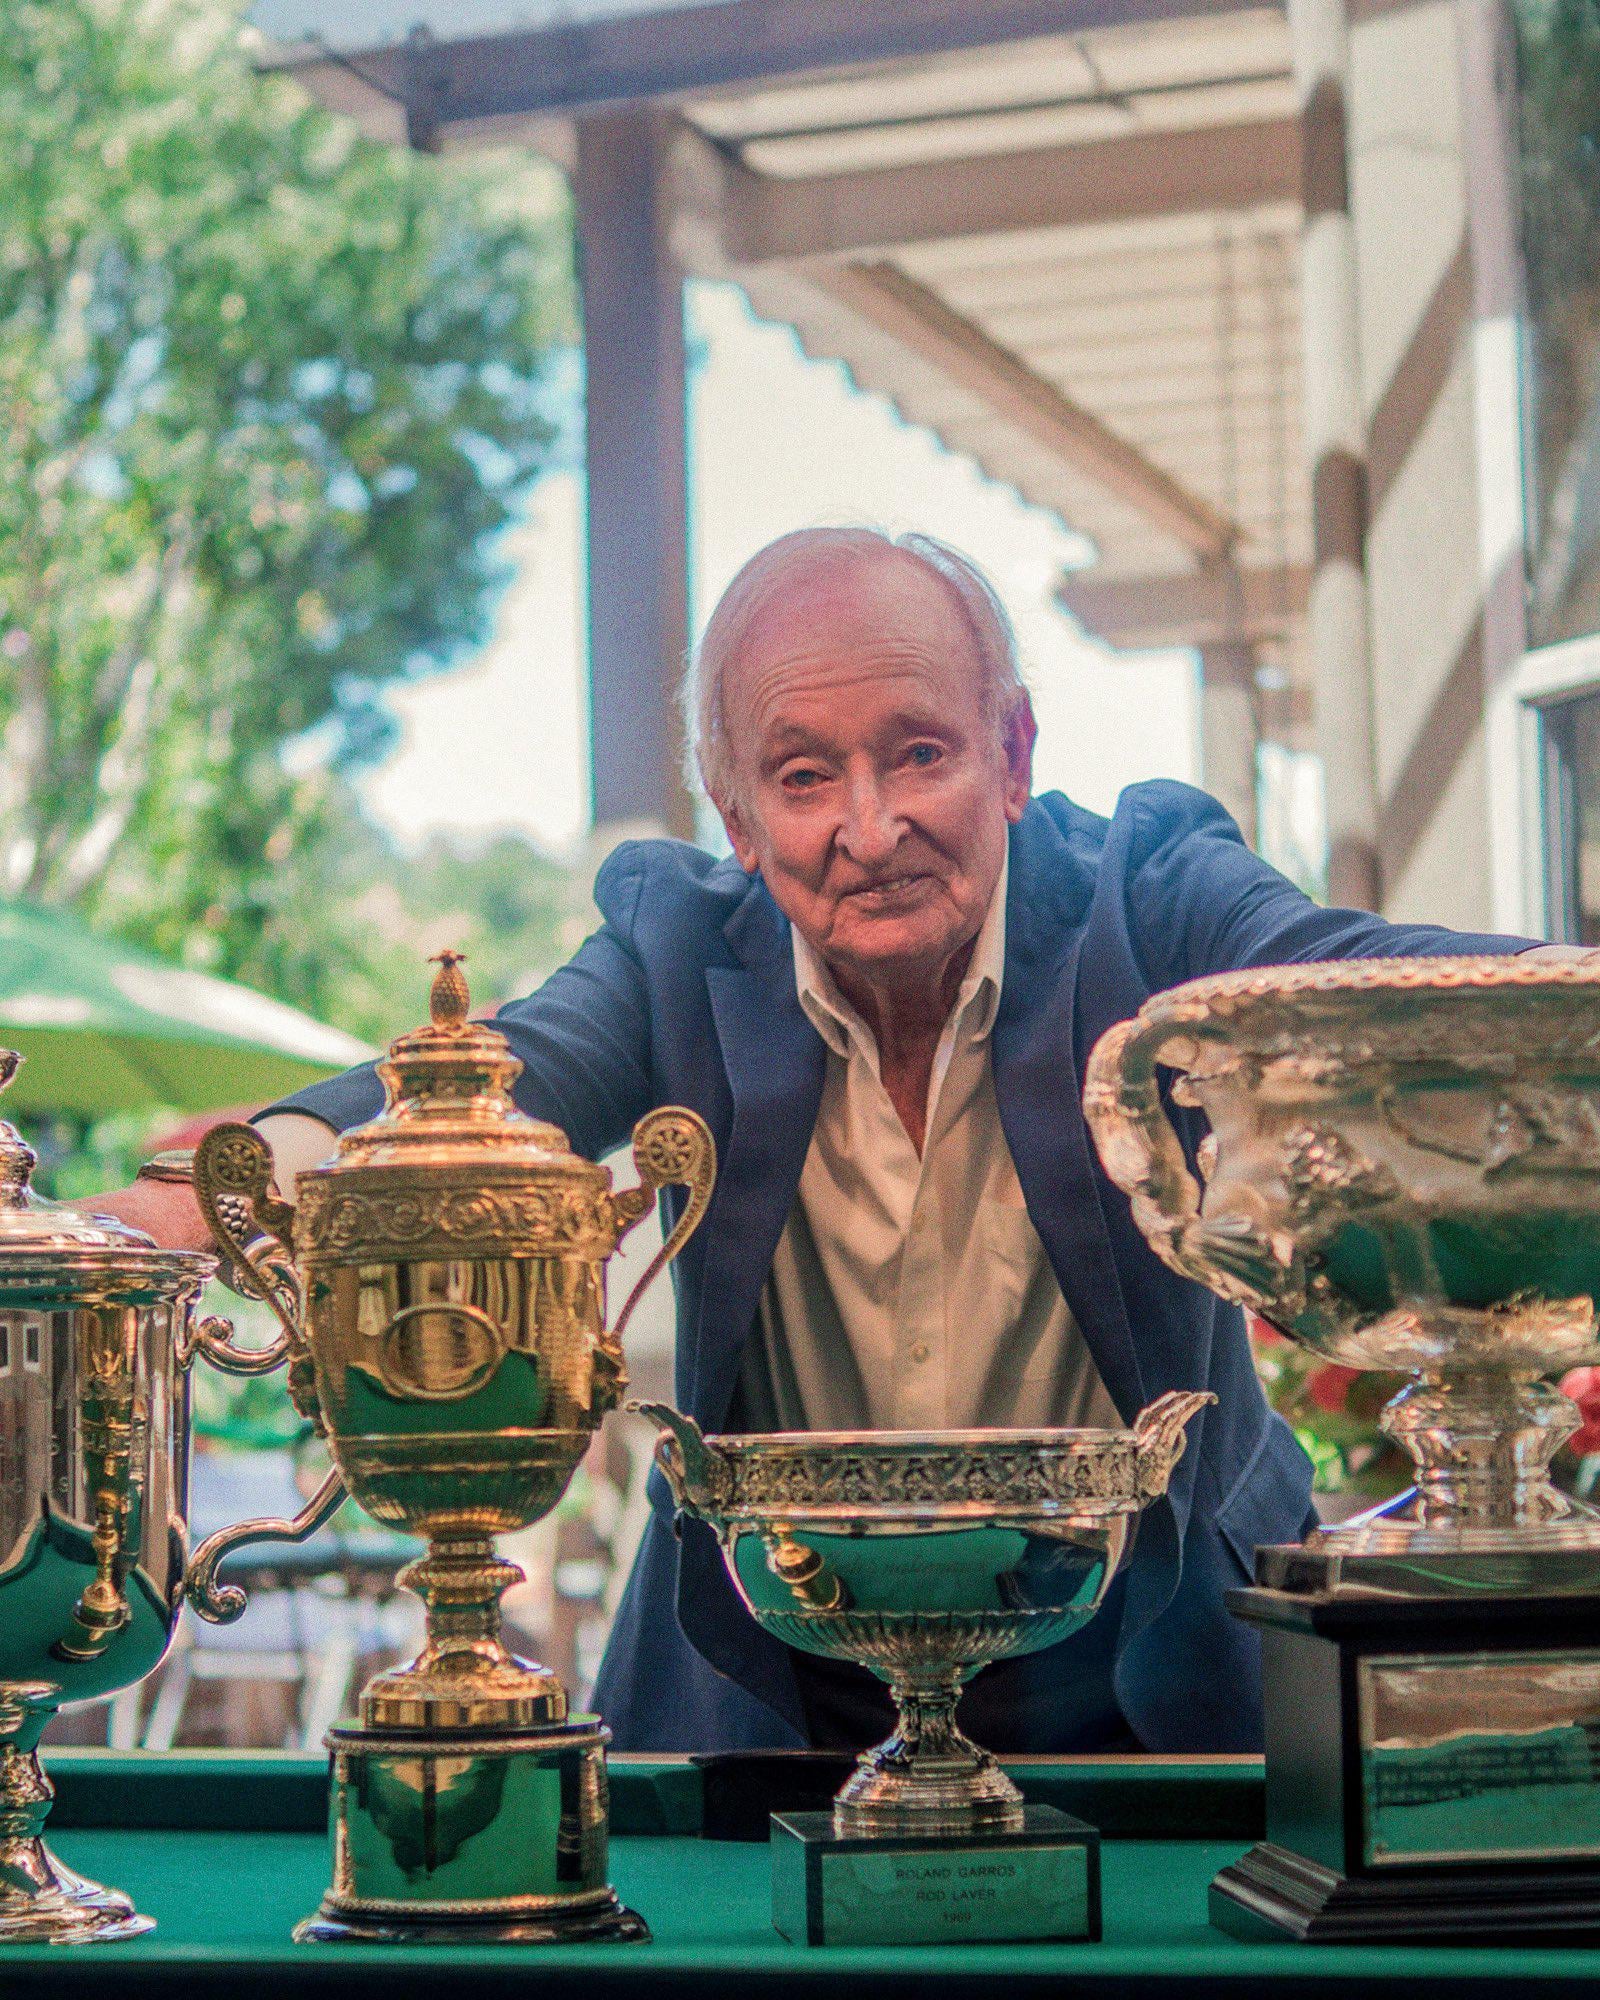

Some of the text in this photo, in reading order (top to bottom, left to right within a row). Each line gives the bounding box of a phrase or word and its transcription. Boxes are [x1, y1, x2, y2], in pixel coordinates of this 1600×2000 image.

[896, 1865, 1016, 1880] ROLAND GARROS
[916, 1888, 996, 1902] ROD LAVER
